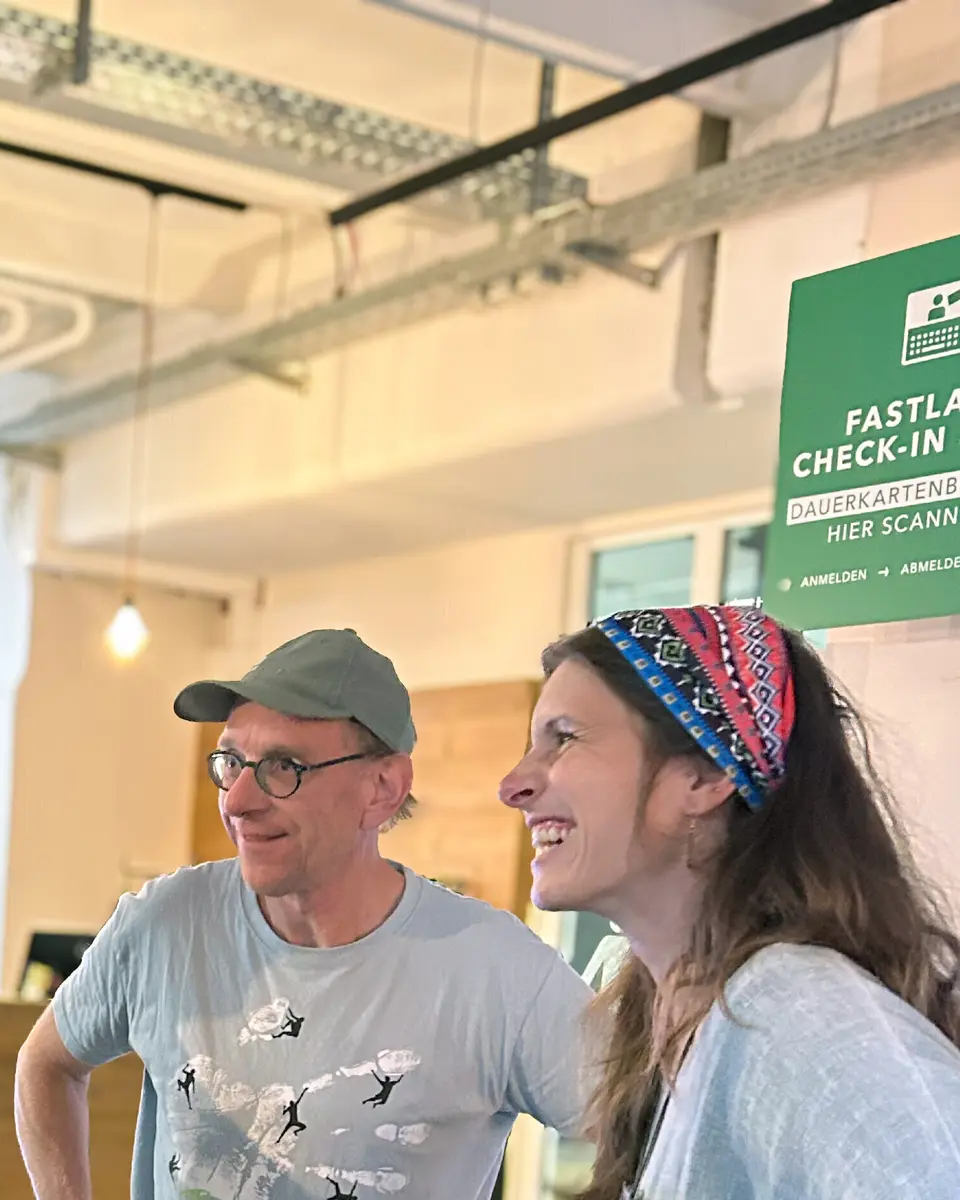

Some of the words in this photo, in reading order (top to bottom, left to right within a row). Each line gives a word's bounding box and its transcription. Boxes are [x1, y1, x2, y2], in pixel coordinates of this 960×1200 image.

[846, 387, 960, 436] FASTLA
[793, 426, 946, 478] CHECK-IN
[791, 476, 958, 520] DAUERKARTENB
[827, 519, 874, 543] HIER
[881, 506, 959, 535] SCANN
[800, 568, 867, 588] ANMELDEN
